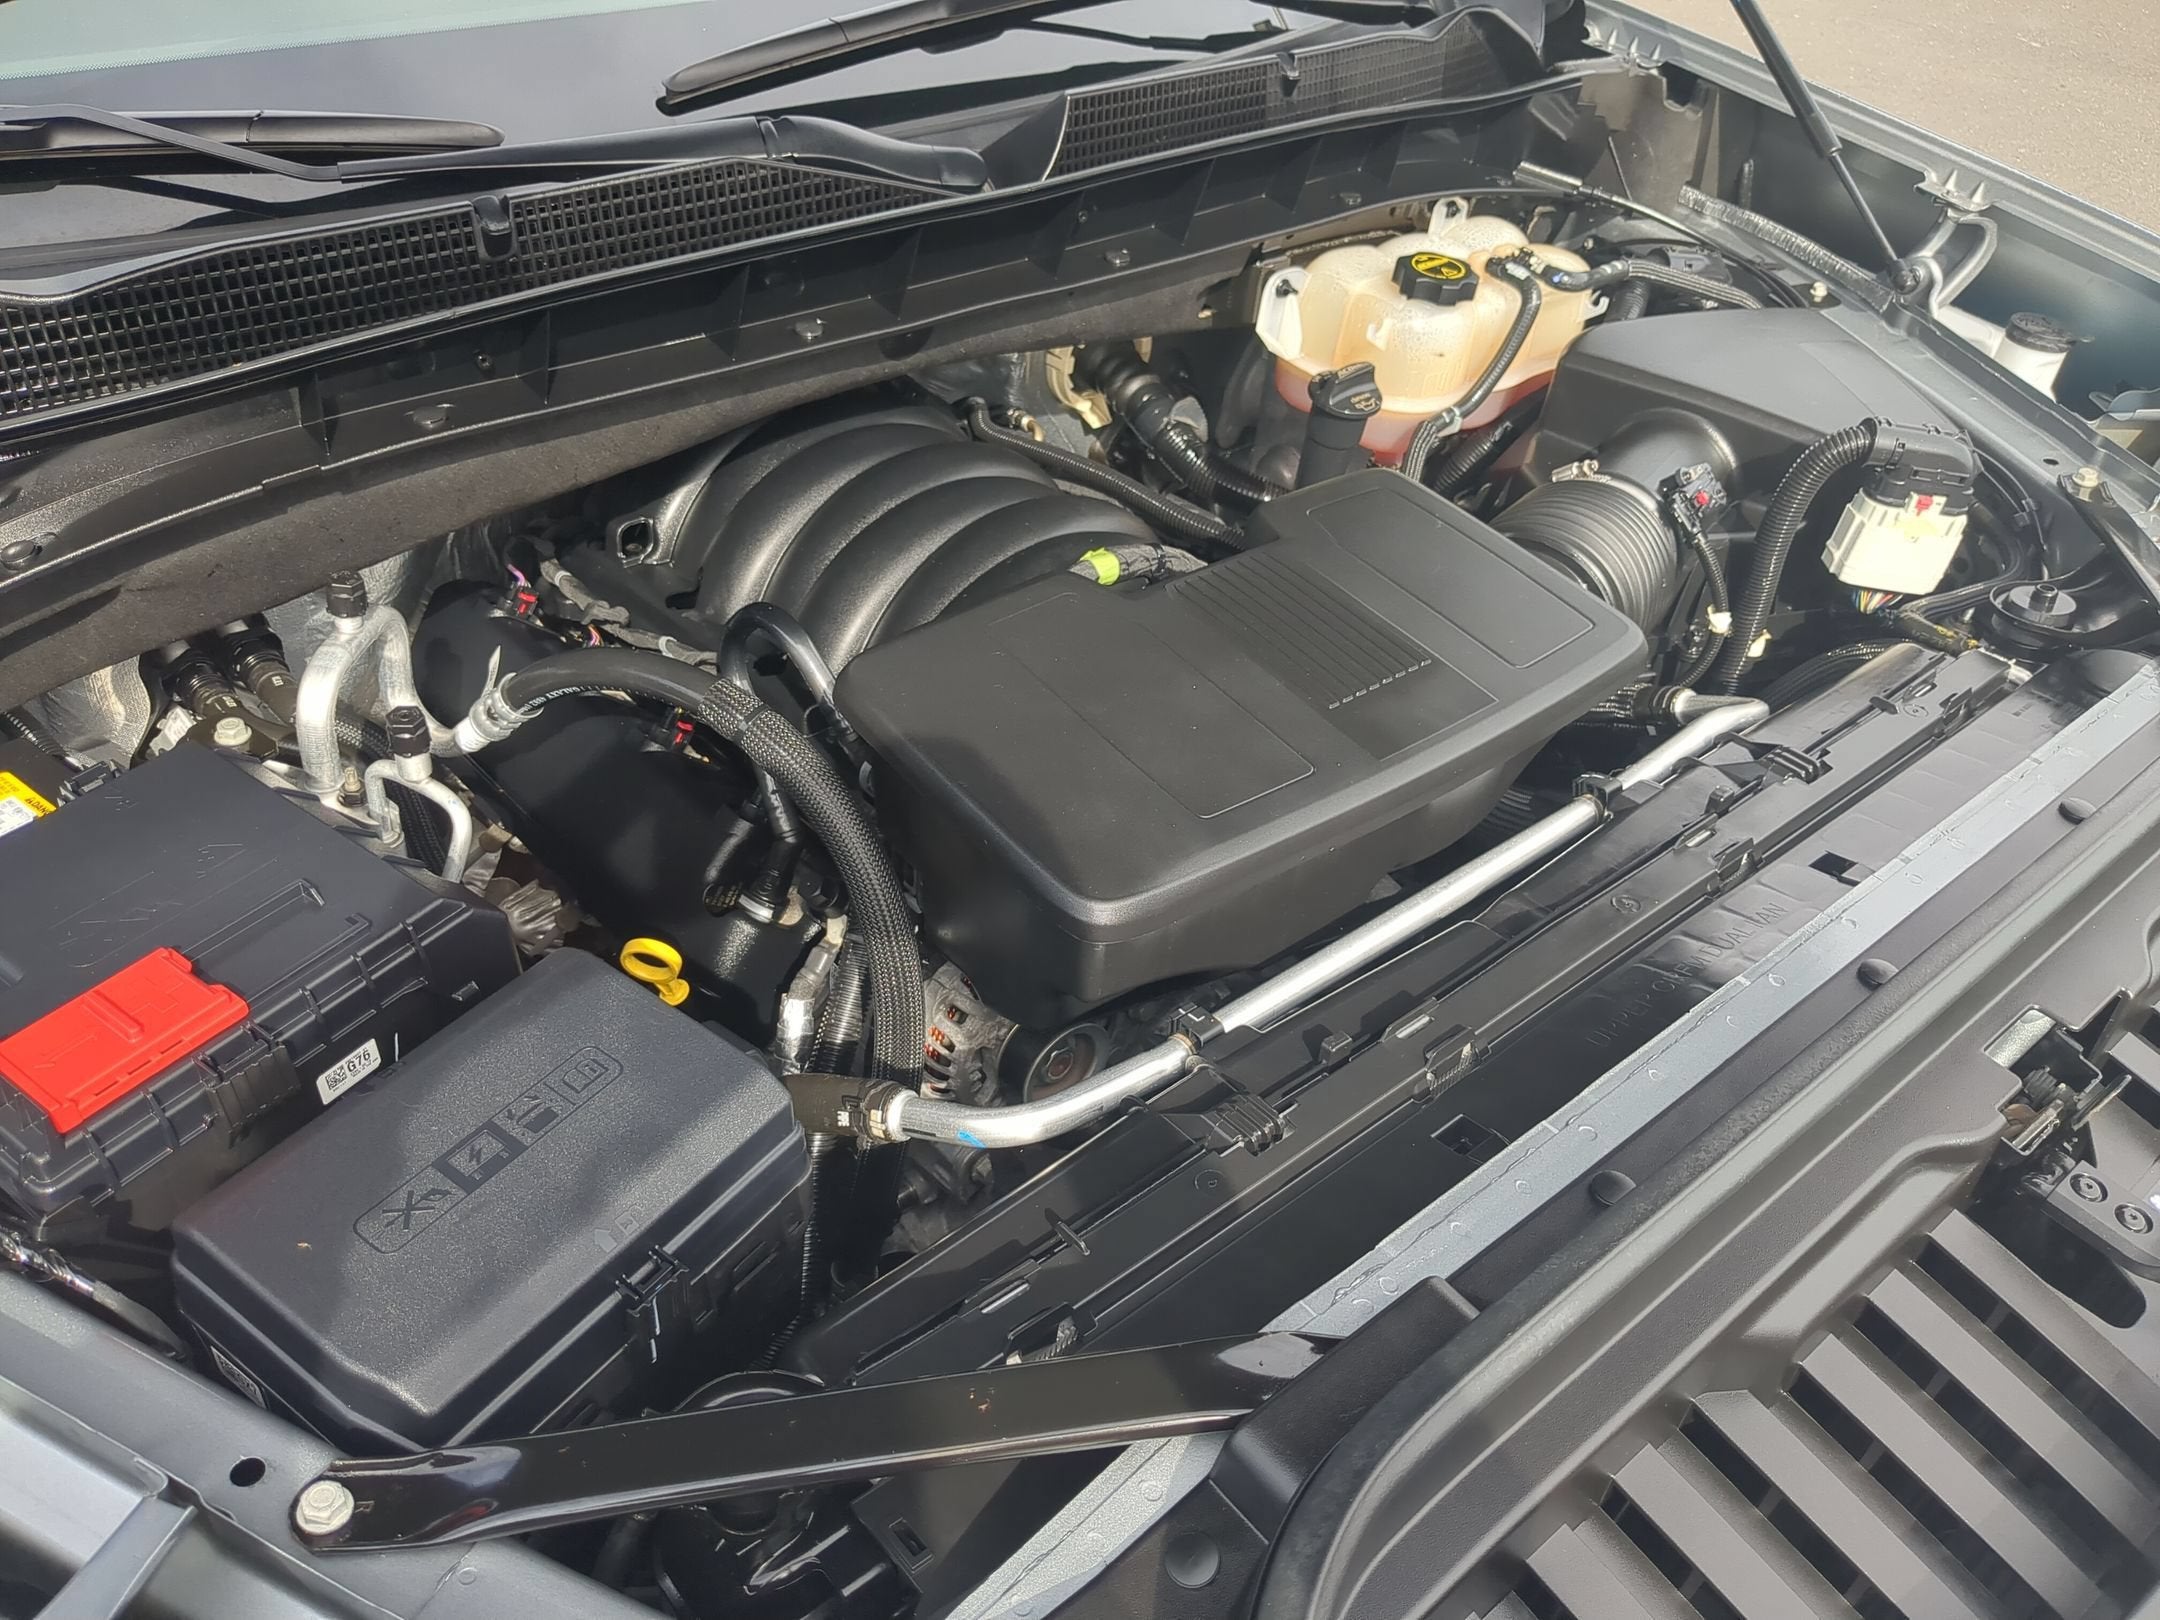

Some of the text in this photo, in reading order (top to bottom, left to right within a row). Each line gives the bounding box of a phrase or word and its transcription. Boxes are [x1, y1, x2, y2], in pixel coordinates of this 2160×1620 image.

[545, 686, 581, 699] GALAXY
[1698, 927, 1753, 960] DUAL
[347, 1051, 370, 1072] G76
